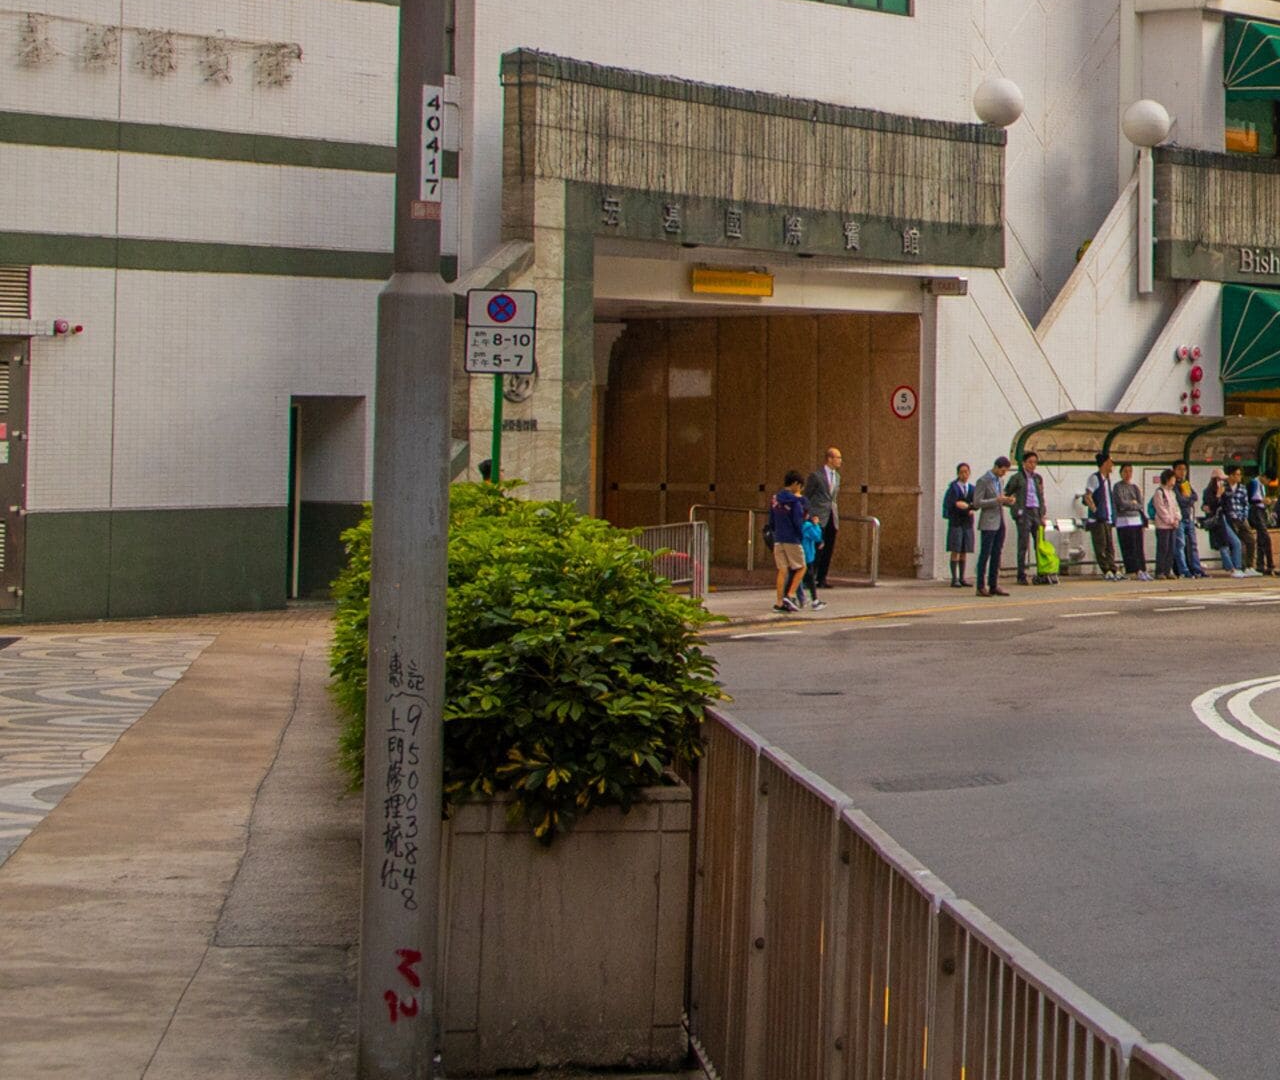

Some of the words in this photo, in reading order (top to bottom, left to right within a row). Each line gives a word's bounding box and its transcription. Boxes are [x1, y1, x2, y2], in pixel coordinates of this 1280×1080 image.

[426, 94, 441, 195] 40417
[492, 333, 531, 347] 8-10
[901, 393, 908, 404] 5
